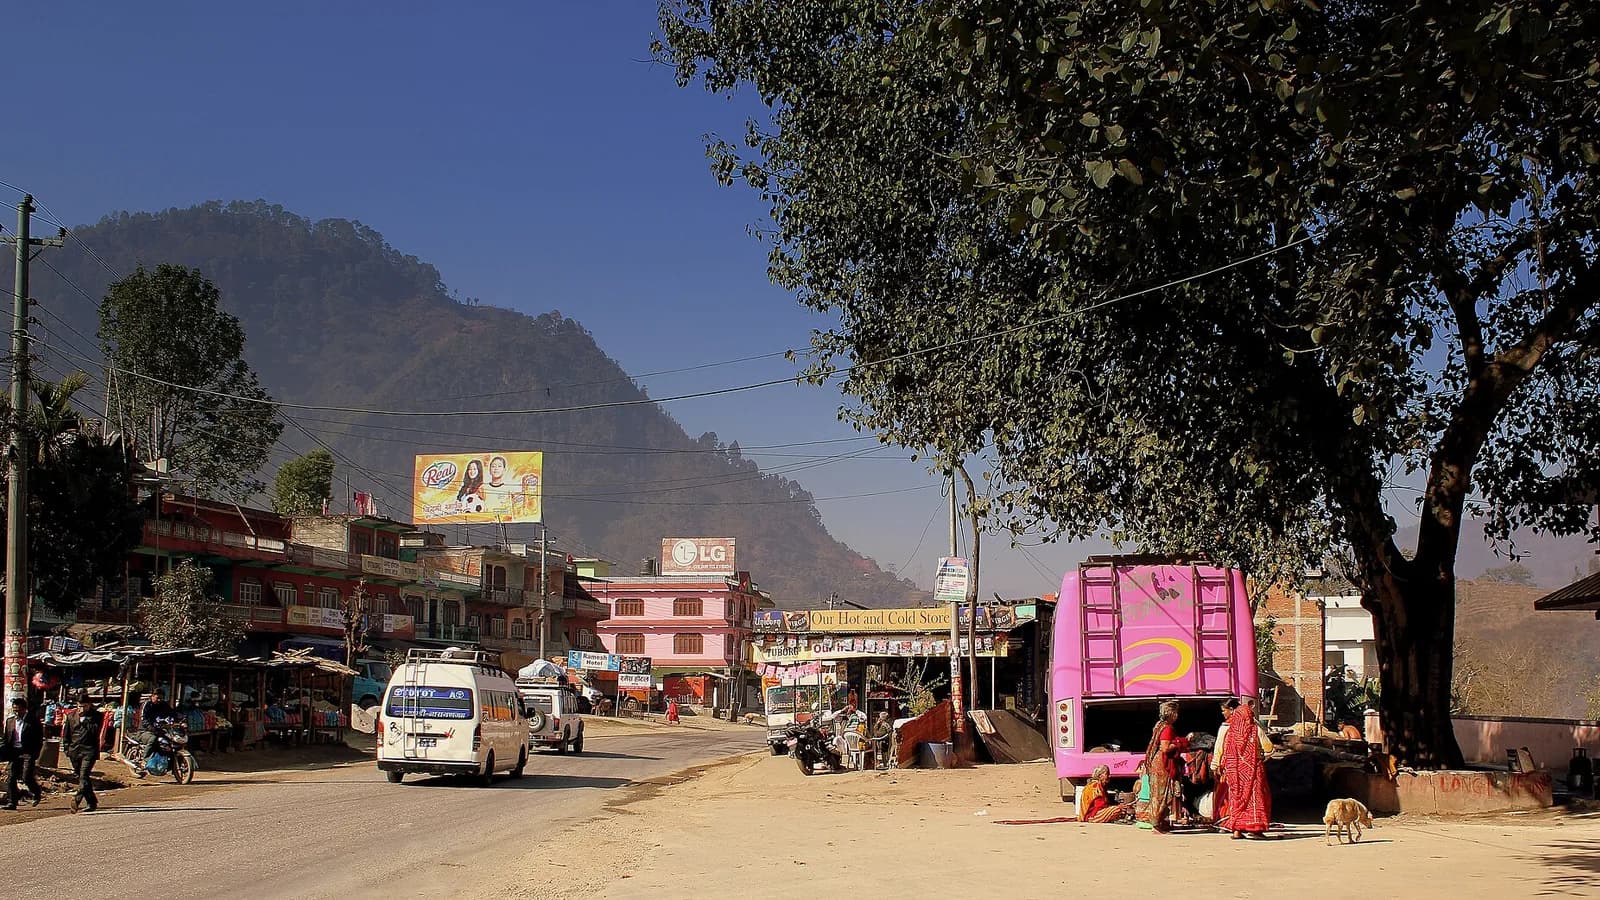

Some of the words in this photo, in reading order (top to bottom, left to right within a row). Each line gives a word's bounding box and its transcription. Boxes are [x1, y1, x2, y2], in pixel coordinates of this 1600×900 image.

[426, 464, 453, 486] Real
[700, 545, 726, 562] LG
[811, 611, 834, 625] Our
[839, 611, 861, 625] Hot
[863, 610, 884, 625] and
[888, 610, 916, 625] Cold
[919, 610, 950, 625] Store
[583, 653, 607, 661] Ramesh
[766, 646, 799, 657] TUBORG
